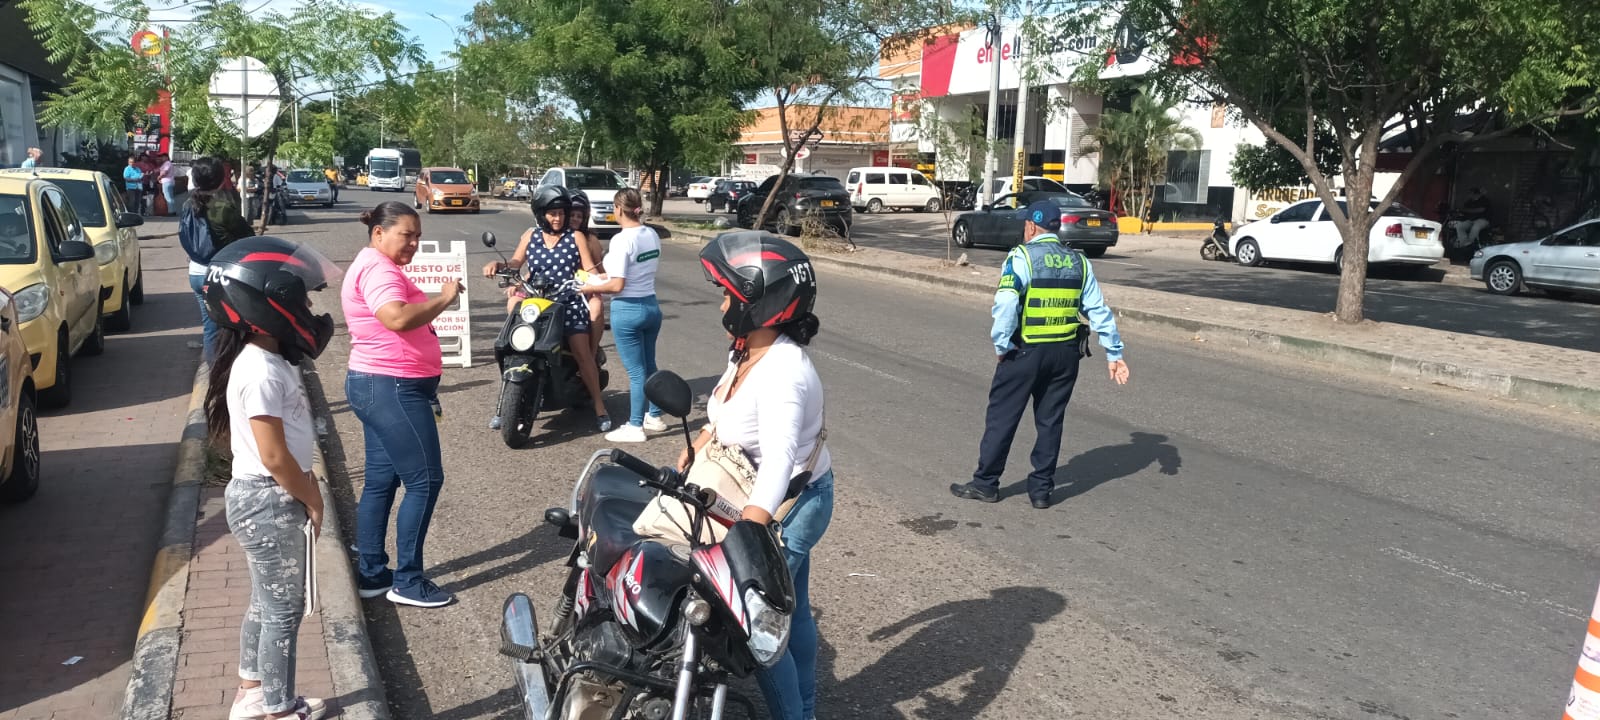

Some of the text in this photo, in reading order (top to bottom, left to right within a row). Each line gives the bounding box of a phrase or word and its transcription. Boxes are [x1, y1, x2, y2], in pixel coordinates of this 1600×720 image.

[1044, 253, 1074, 269] 034
[446, 264, 462, 273] DE
[408, 275, 453, 284] ONTROL
